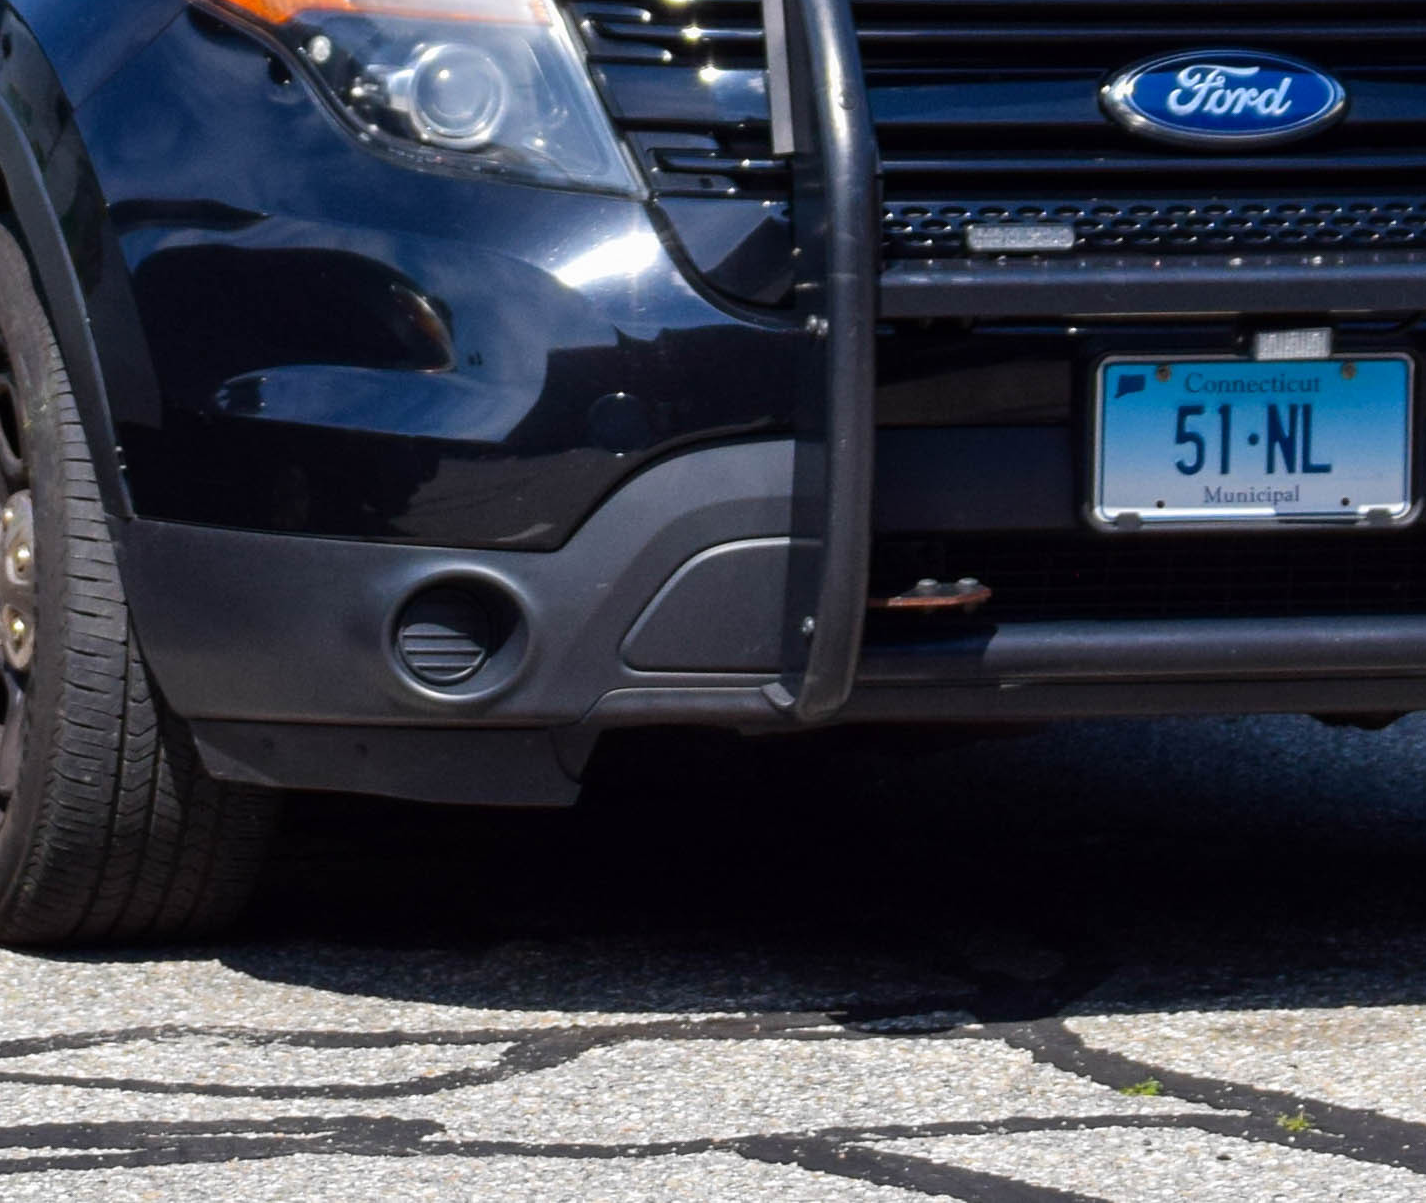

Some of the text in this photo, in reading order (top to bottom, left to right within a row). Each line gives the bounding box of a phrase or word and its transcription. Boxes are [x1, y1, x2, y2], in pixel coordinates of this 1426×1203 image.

[1166, 64, 1293, 117] Ford
[1184, 373, 1322, 394] Connecticut
[1203, 485, 1300, 506] Municipal
